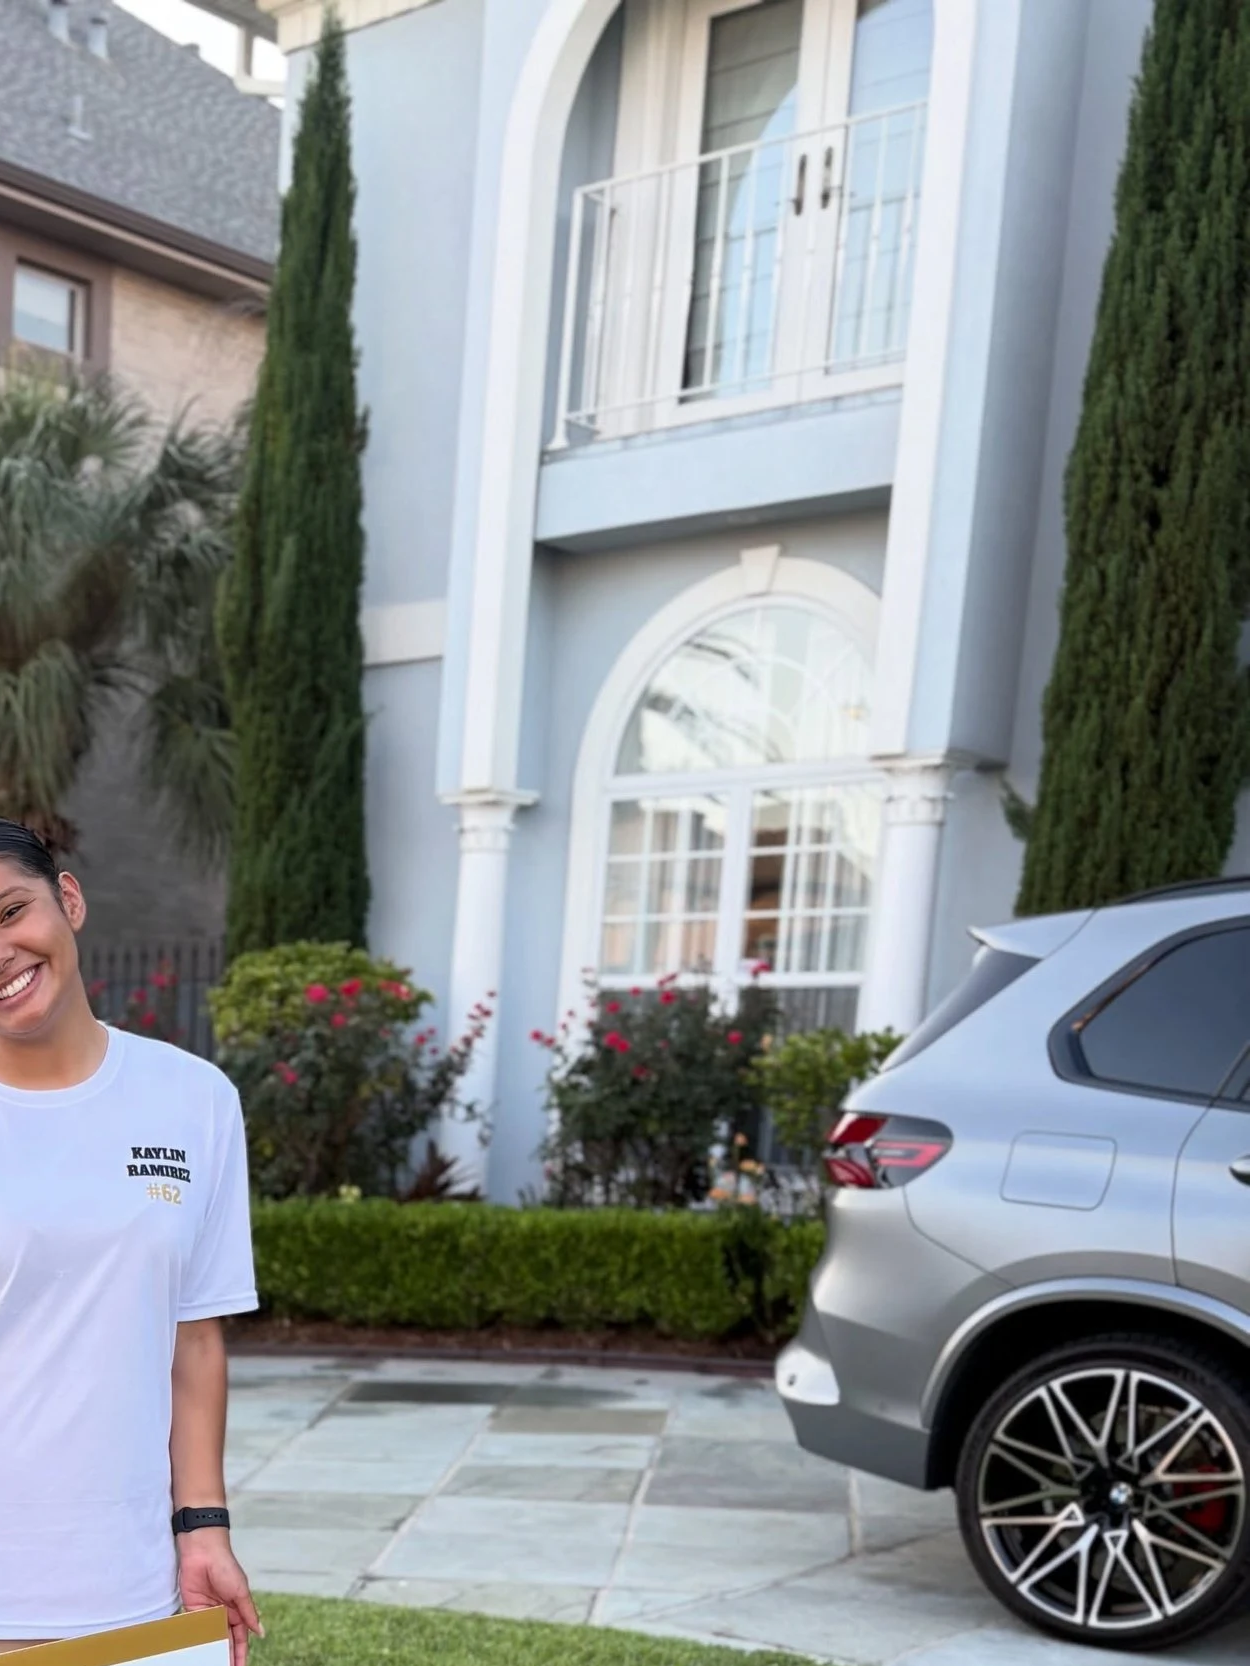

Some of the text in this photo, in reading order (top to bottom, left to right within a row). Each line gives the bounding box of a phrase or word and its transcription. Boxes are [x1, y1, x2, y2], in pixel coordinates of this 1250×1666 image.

[131, 1147, 185, 1162] KAYLIN
[126, 1164, 191, 1183] RAMIREZ
[146, 1183, 181, 1204] #62
